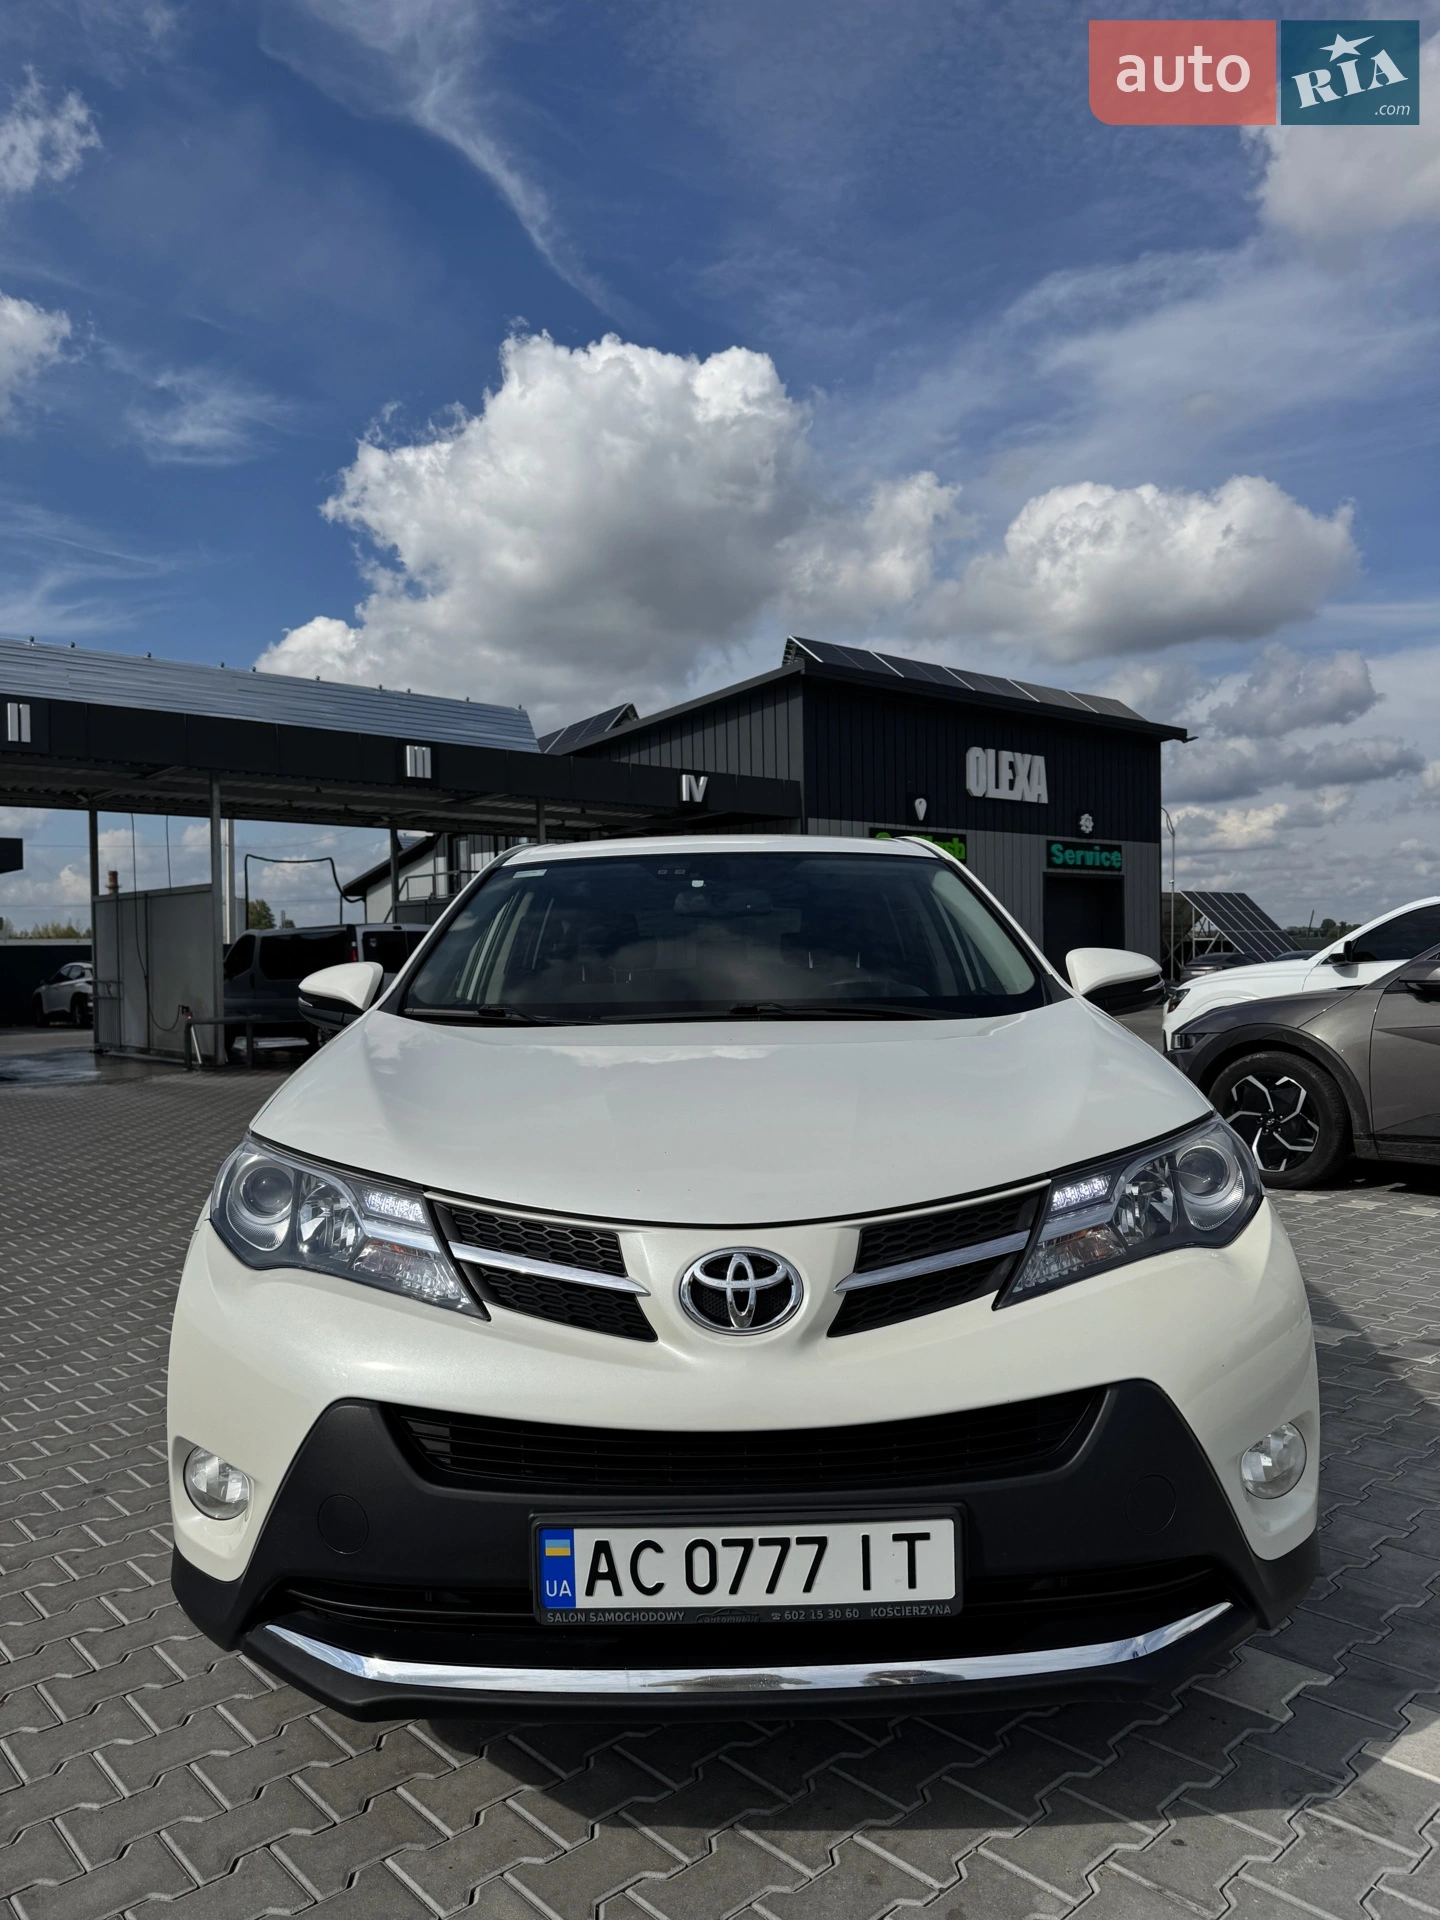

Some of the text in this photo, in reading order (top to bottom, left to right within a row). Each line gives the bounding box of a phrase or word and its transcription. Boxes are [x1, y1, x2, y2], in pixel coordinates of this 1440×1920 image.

[681, 774, 708, 803] IV
[965, 746, 1049, 804] OLEXA
[1050, 843, 1123, 869] Service
[584, 1532, 931, 1597] AC 0777 IT
[545, 1580, 572, 1597] UA
[547, 1612, 586, 1622] SALON
[589, 1611, 685, 1622] SAMOCHODOWY
[784, 1609, 806, 1620] 602
[810, 1609, 824, 1620] 15
[828, 1608, 842, 1619] 30
[845, 1608, 860, 1619] 60
